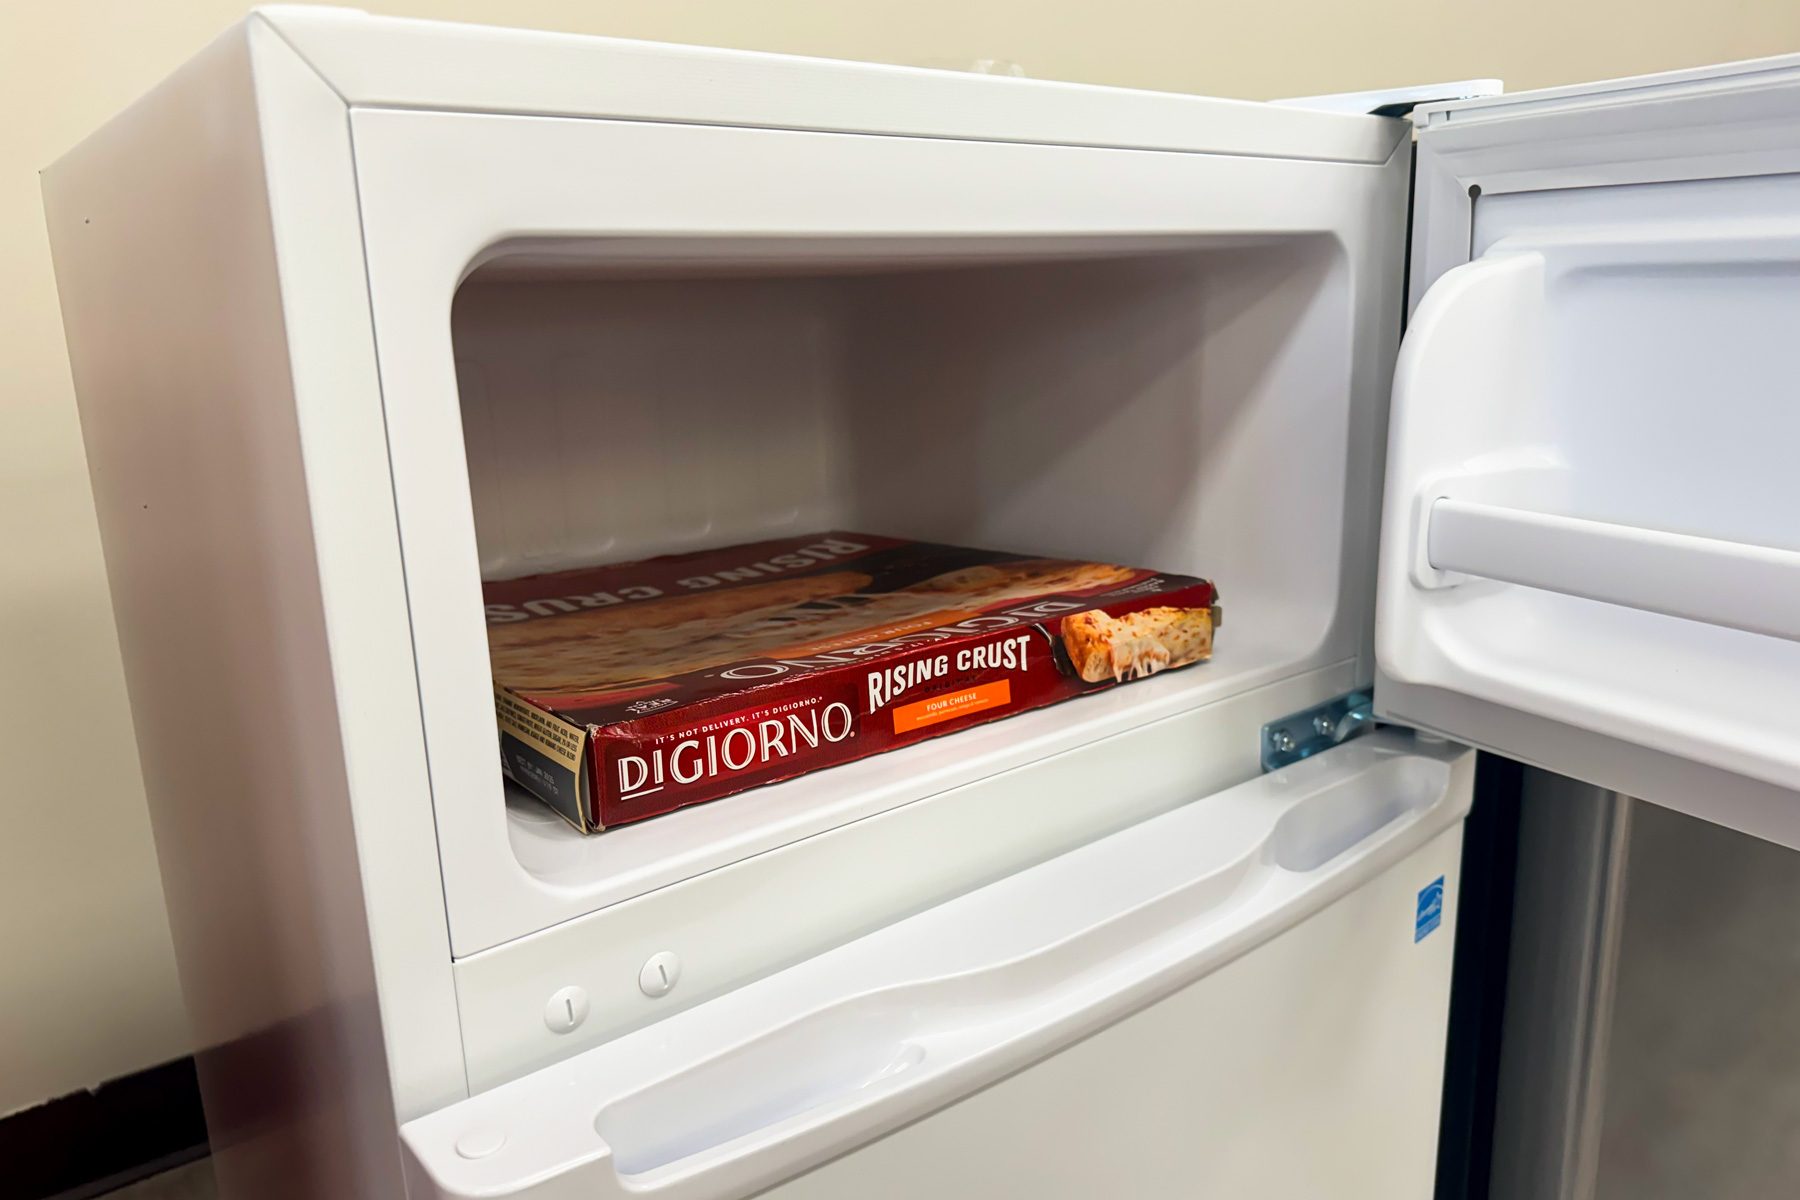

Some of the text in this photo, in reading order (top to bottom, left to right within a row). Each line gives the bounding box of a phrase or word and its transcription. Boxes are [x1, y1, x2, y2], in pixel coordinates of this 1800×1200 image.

[486, 539, 871, 624] RISING CRUS
[867, 654, 948, 715] RISING
[956, 634, 1031, 672] CRUST
[926, 699, 948, 712] FOUR
[949, 692, 977, 706] CHEESE
[617, 701, 852, 798] DIGIORNO
[655, 696, 820, 745] IT'S NOT DELIVERY. IT'S DIGIORNO.
